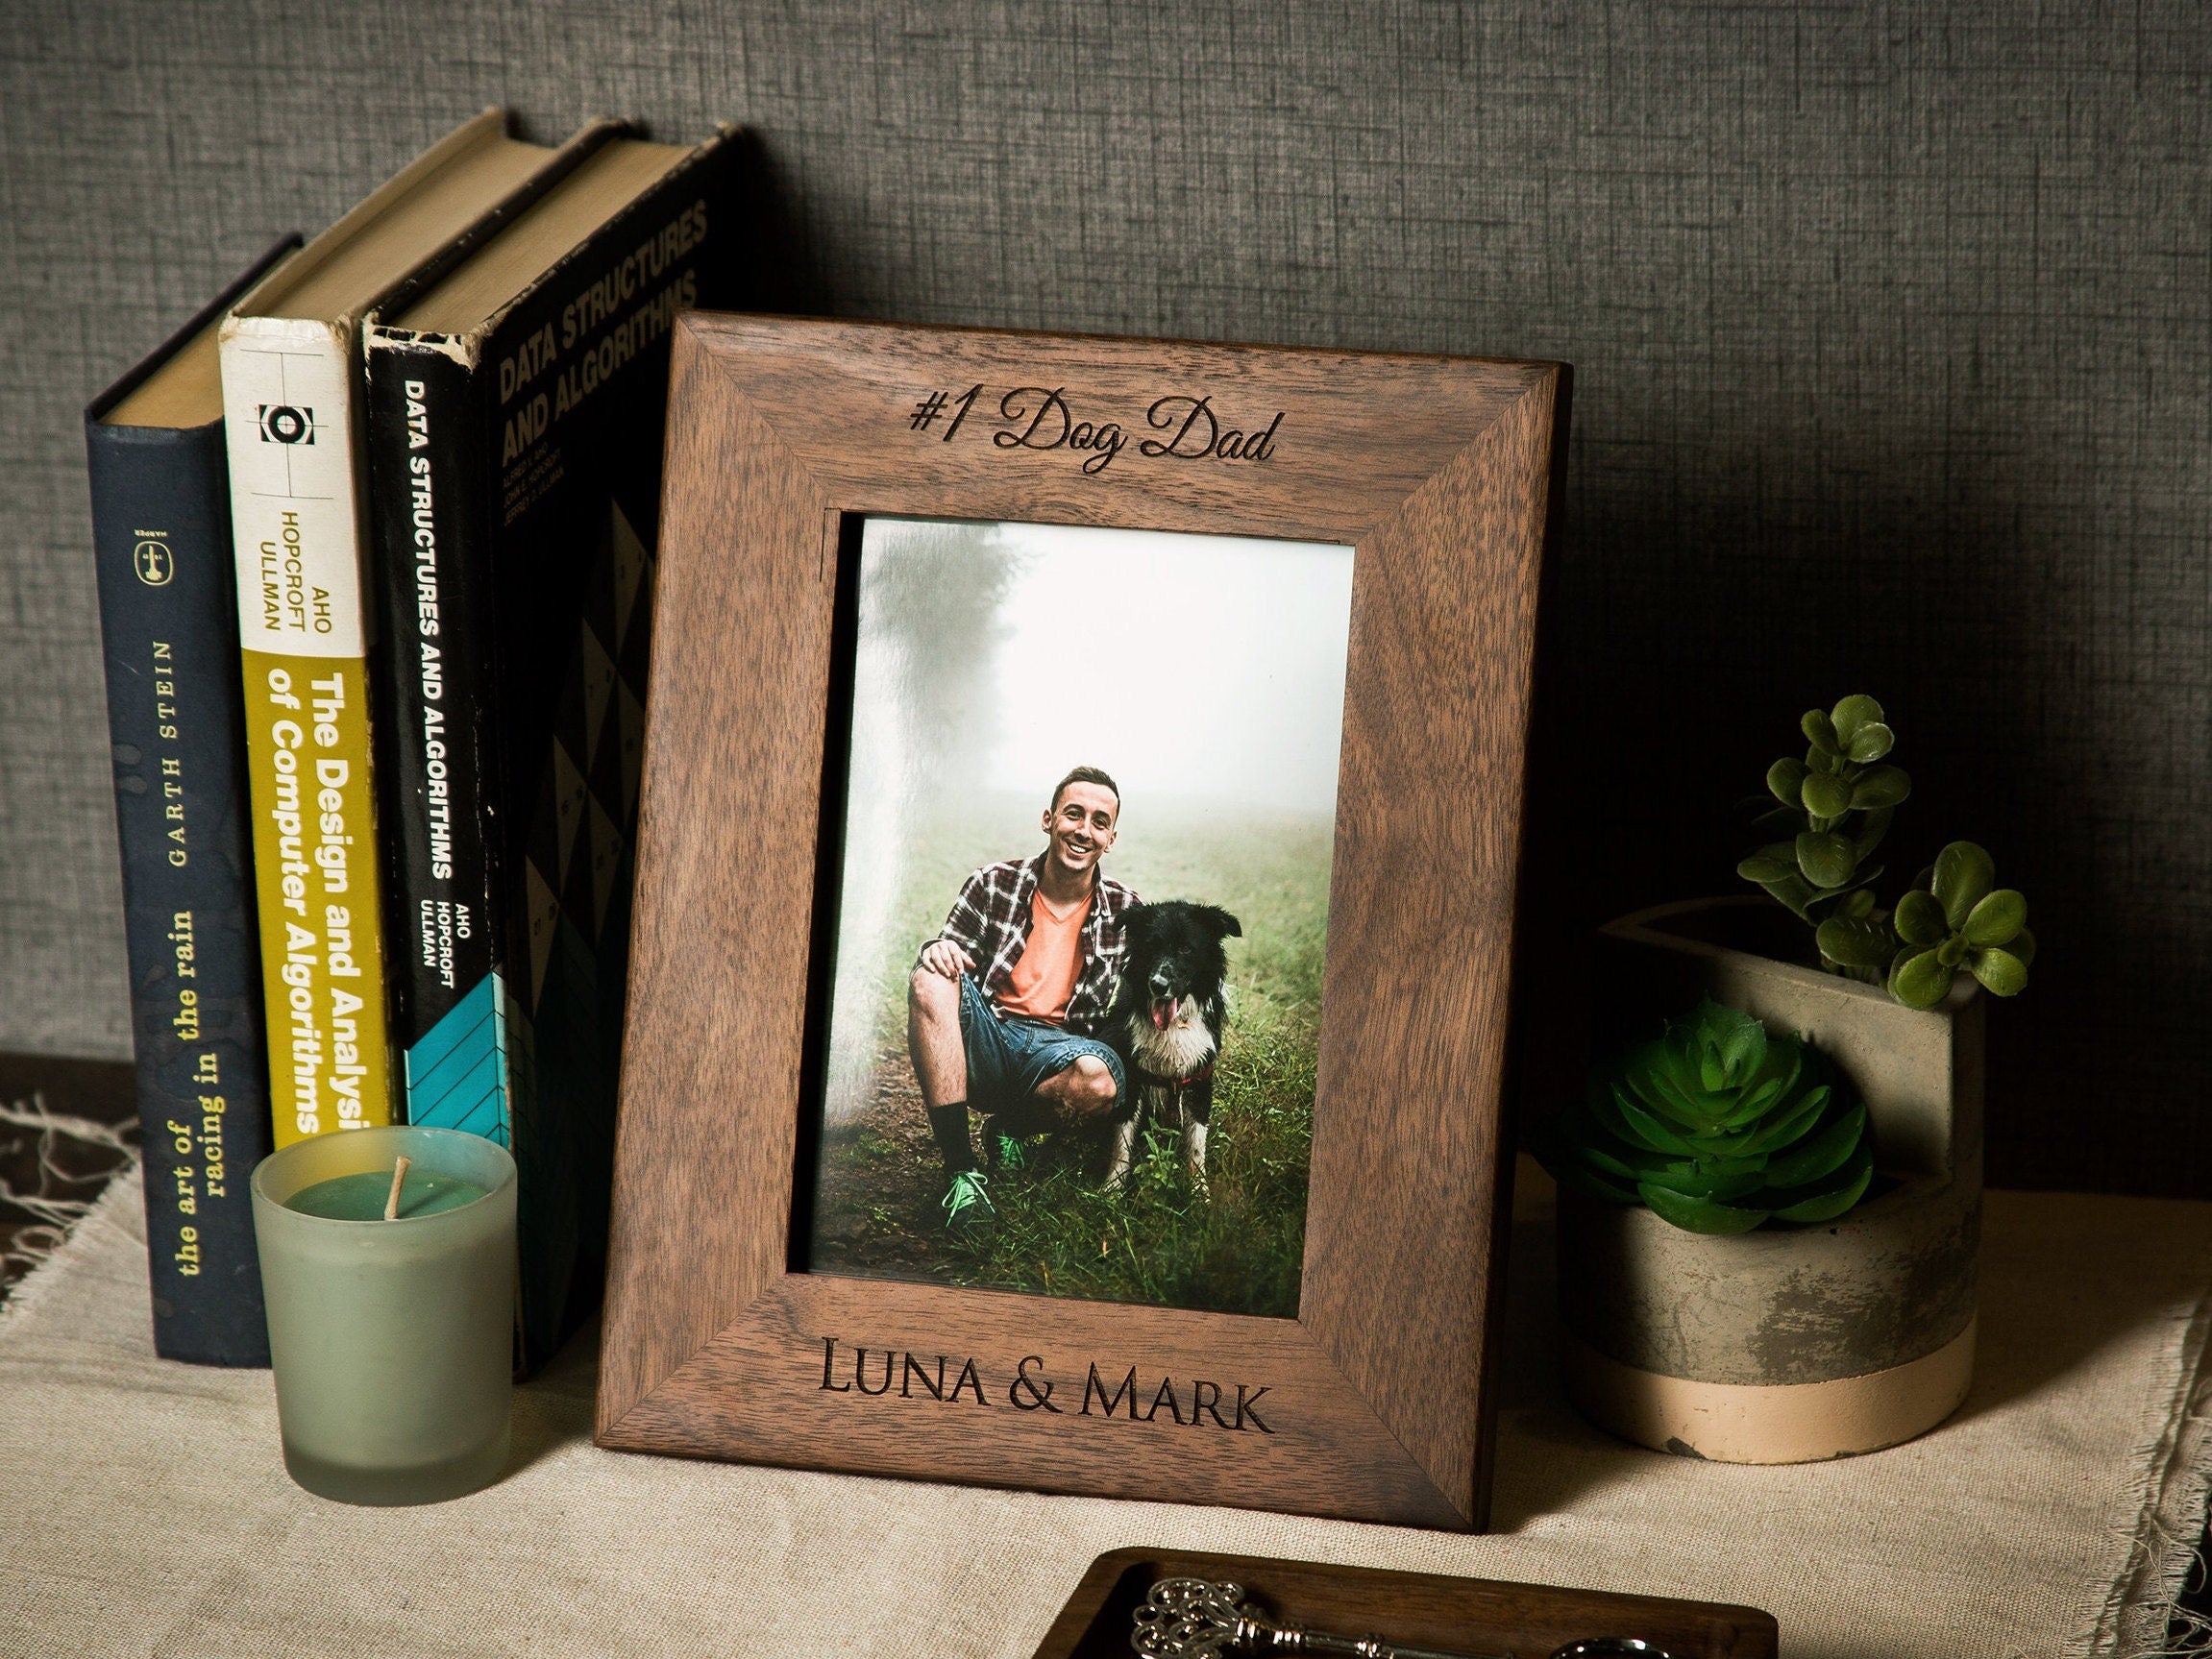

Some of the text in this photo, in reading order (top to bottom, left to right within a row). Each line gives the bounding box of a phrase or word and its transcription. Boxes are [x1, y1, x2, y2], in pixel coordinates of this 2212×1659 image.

[500, 199, 707, 404] DATA STRUCTURES
[503, 269, 697, 467] AND ALGORITHMS
[910, 383, 1286, 475] #1 Dog Dad
[259, 541, 282, 631] ULLMAN
[281, 511, 306, 632] HOPCROFT
[311, 586, 332, 634] AHO
[405, 380, 453, 881] DATA STRUCTURES AND ALGORITHMS
[154, 641, 187, 867] GARTH STEIN
[268, 669, 323, 1134] of Computer Algorithms
[309, 672, 371, 1129] The Design and Analysi
[420, 899, 436, 968] ULLMAN
[436, 901, 455, 989] HOPCROFT
[455, 904, 471, 939] AHO
[168, 911, 199, 1042] the rain
[193, 1053, 225, 1198] racing in
[167, 1120, 200, 1278] the art of
[819, 1336, 1275, 1434] LUNA & MARK
